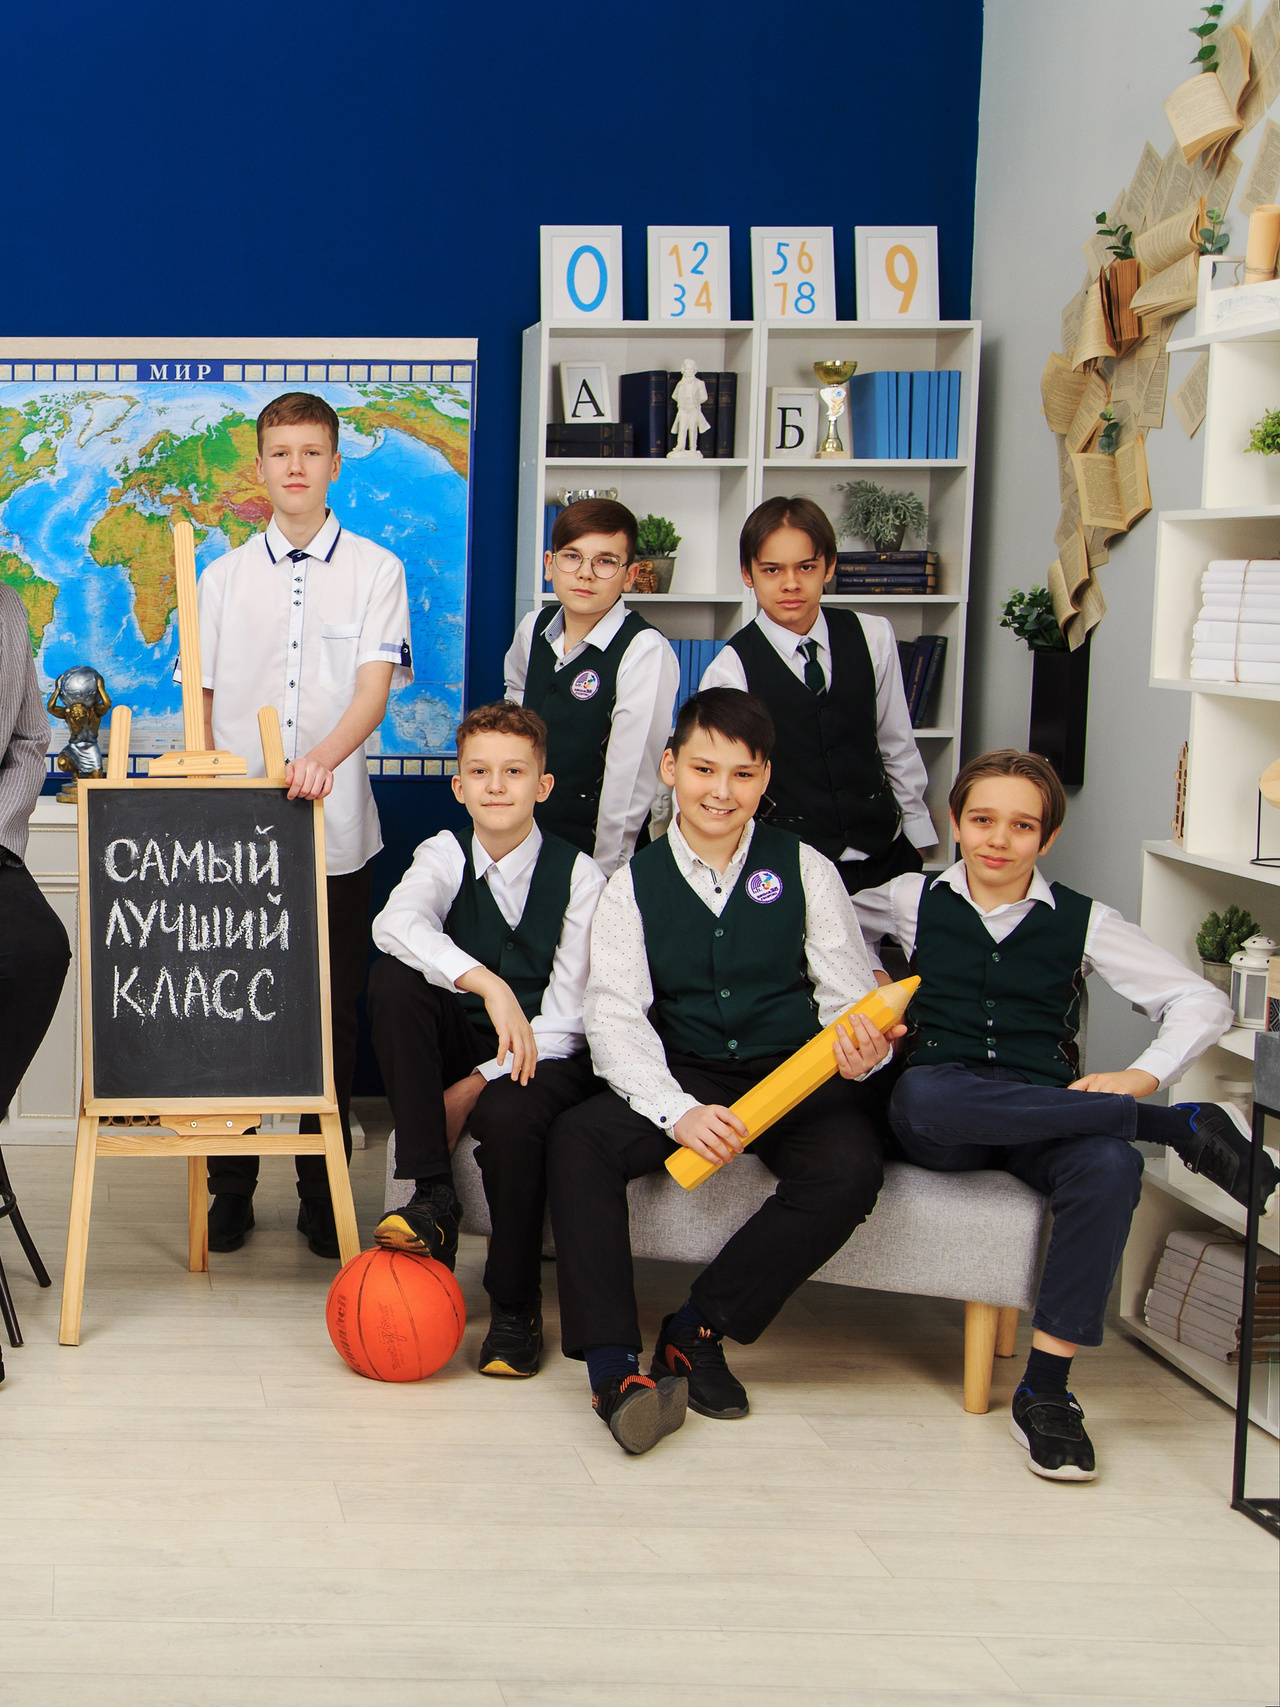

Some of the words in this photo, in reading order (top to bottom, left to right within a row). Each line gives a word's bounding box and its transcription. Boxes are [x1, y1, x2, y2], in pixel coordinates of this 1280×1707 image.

[566, 244, 608, 312] 0
[885, 244, 919, 315] 9
[149, 364, 212, 381] МИР
[571, 378, 605, 418] А
[775, 406, 805, 450] Б
[104, 825, 280, 887] САМЫЙ
[105, 892, 289, 952] ЛУЧШИЙ
[111, 965, 276, 1024] КЛАСС
